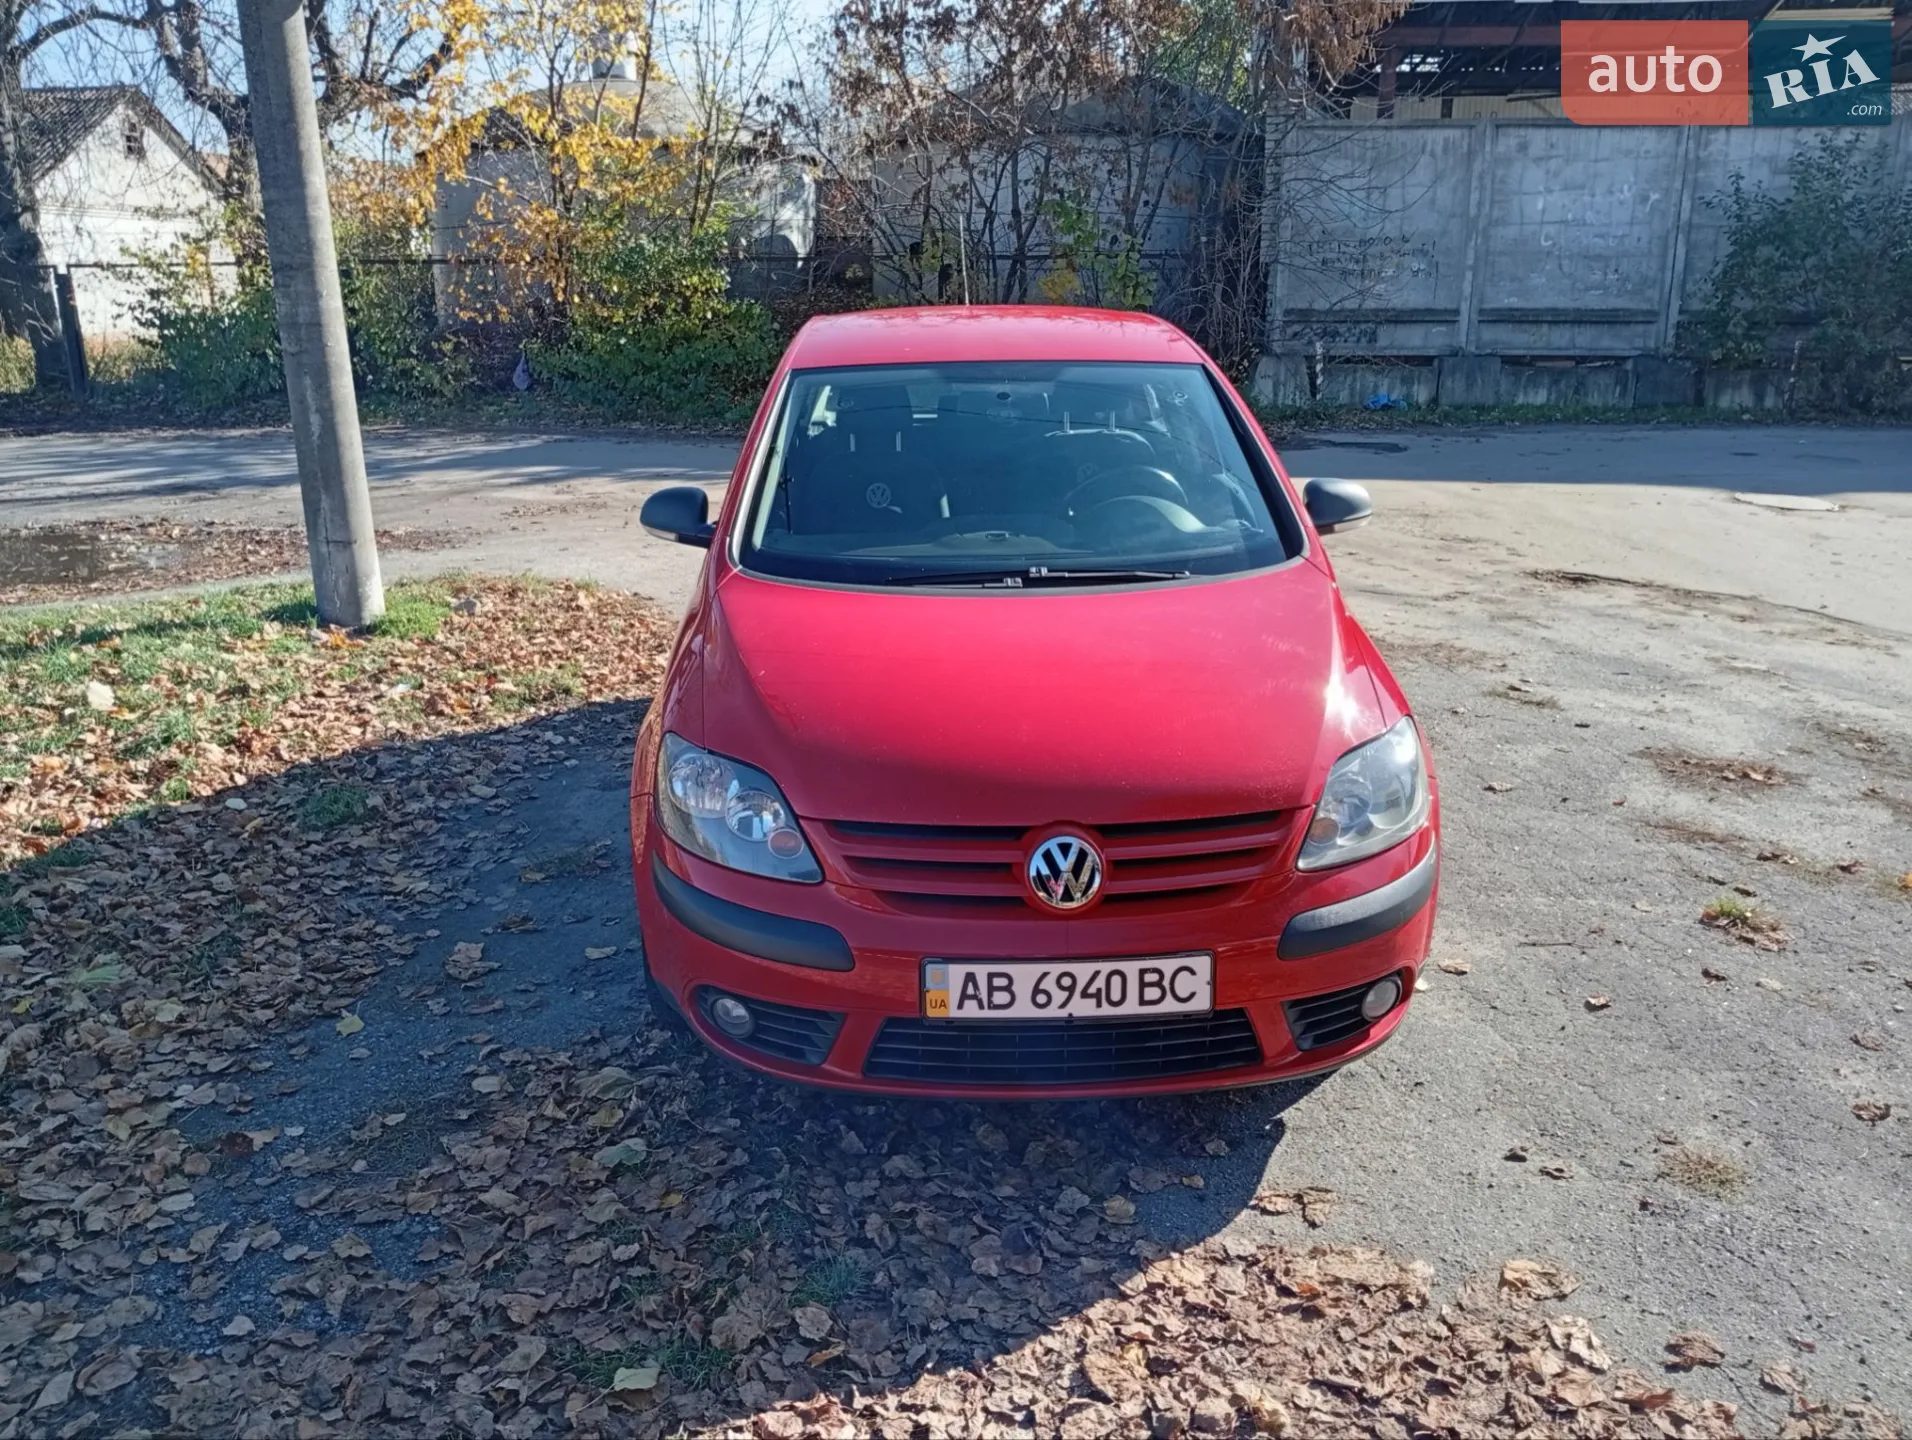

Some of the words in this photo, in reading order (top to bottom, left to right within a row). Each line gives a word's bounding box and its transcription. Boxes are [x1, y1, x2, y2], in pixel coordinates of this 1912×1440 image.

[1029, 835, 1102, 909] VW
[929, 998, 948, 1010] UA
[956, 971, 1017, 1010] AB
[1030, 969, 1128, 1010] 6940
[1137, 965, 1197, 1007] BC
